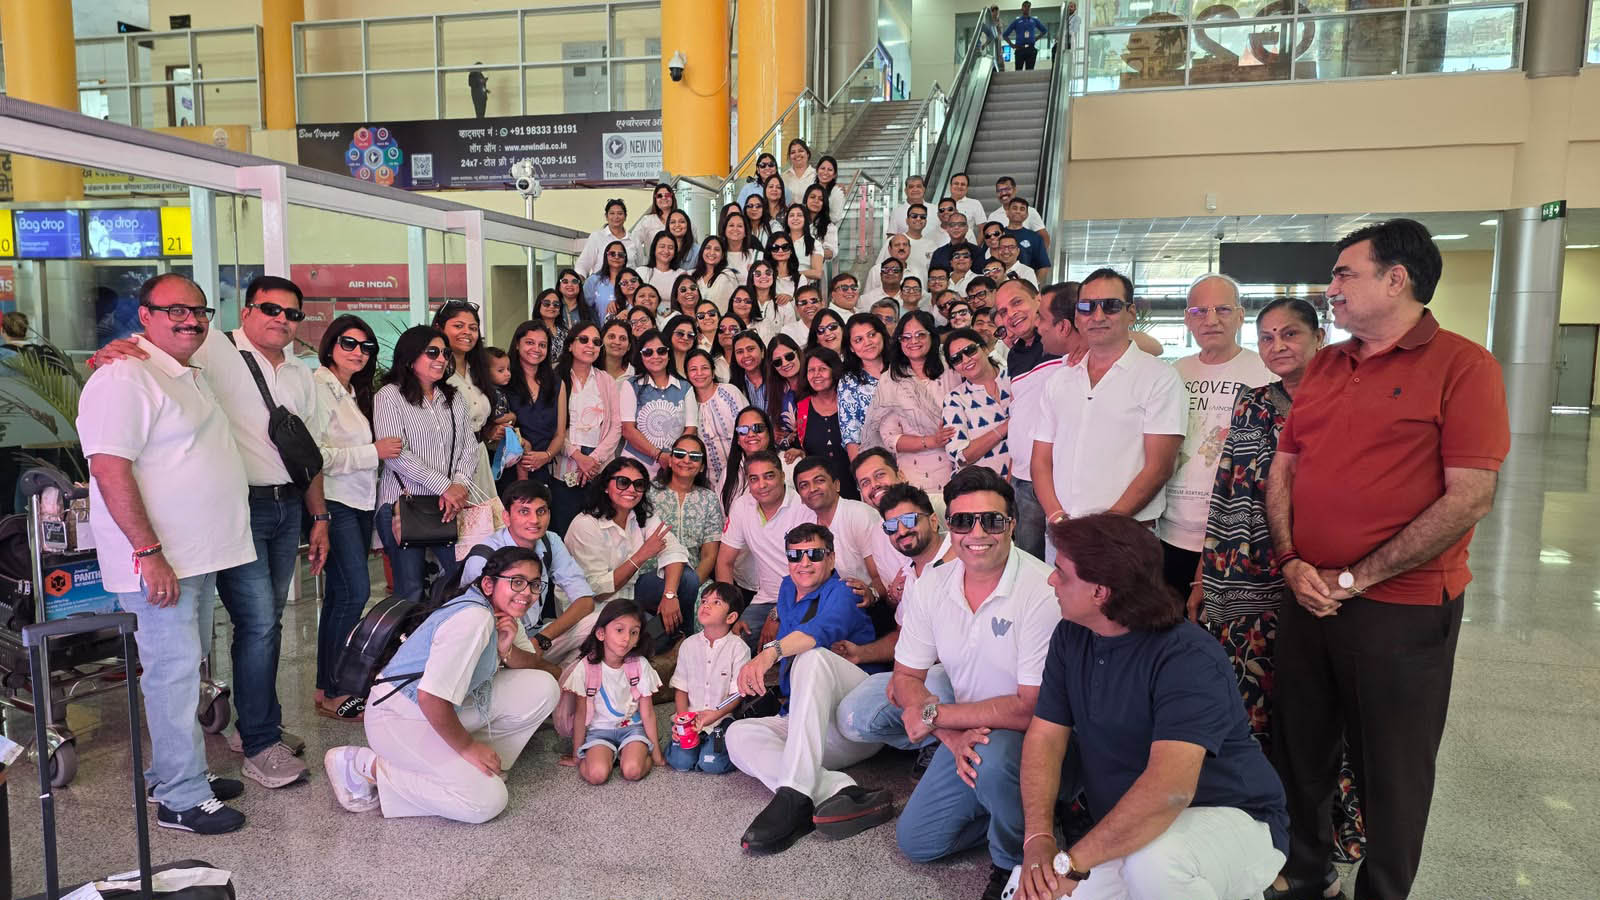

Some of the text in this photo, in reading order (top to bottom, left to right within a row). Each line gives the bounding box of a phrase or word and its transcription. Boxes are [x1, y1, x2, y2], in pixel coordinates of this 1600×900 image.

[298, 128, 340, 140] Bon Voyage
[510, 126, 524, 136] +91
[526, 126, 551, 135] 98333
[553, 124, 577, 134] 19191
[504, 142, 568, 152] www.newindia.co.in
[630, 140, 662, 153] NEW IND
[461, 159, 478, 168] 24x7
[606, 170, 619, 178] The
[19, 217, 65, 233] Bag drop
[114, 216, 139, 231] drop
[167, 237, 183, 251] 21
[1184, 380, 1242, 395] SCOVER
[74, 570, 102, 583] PANTH
